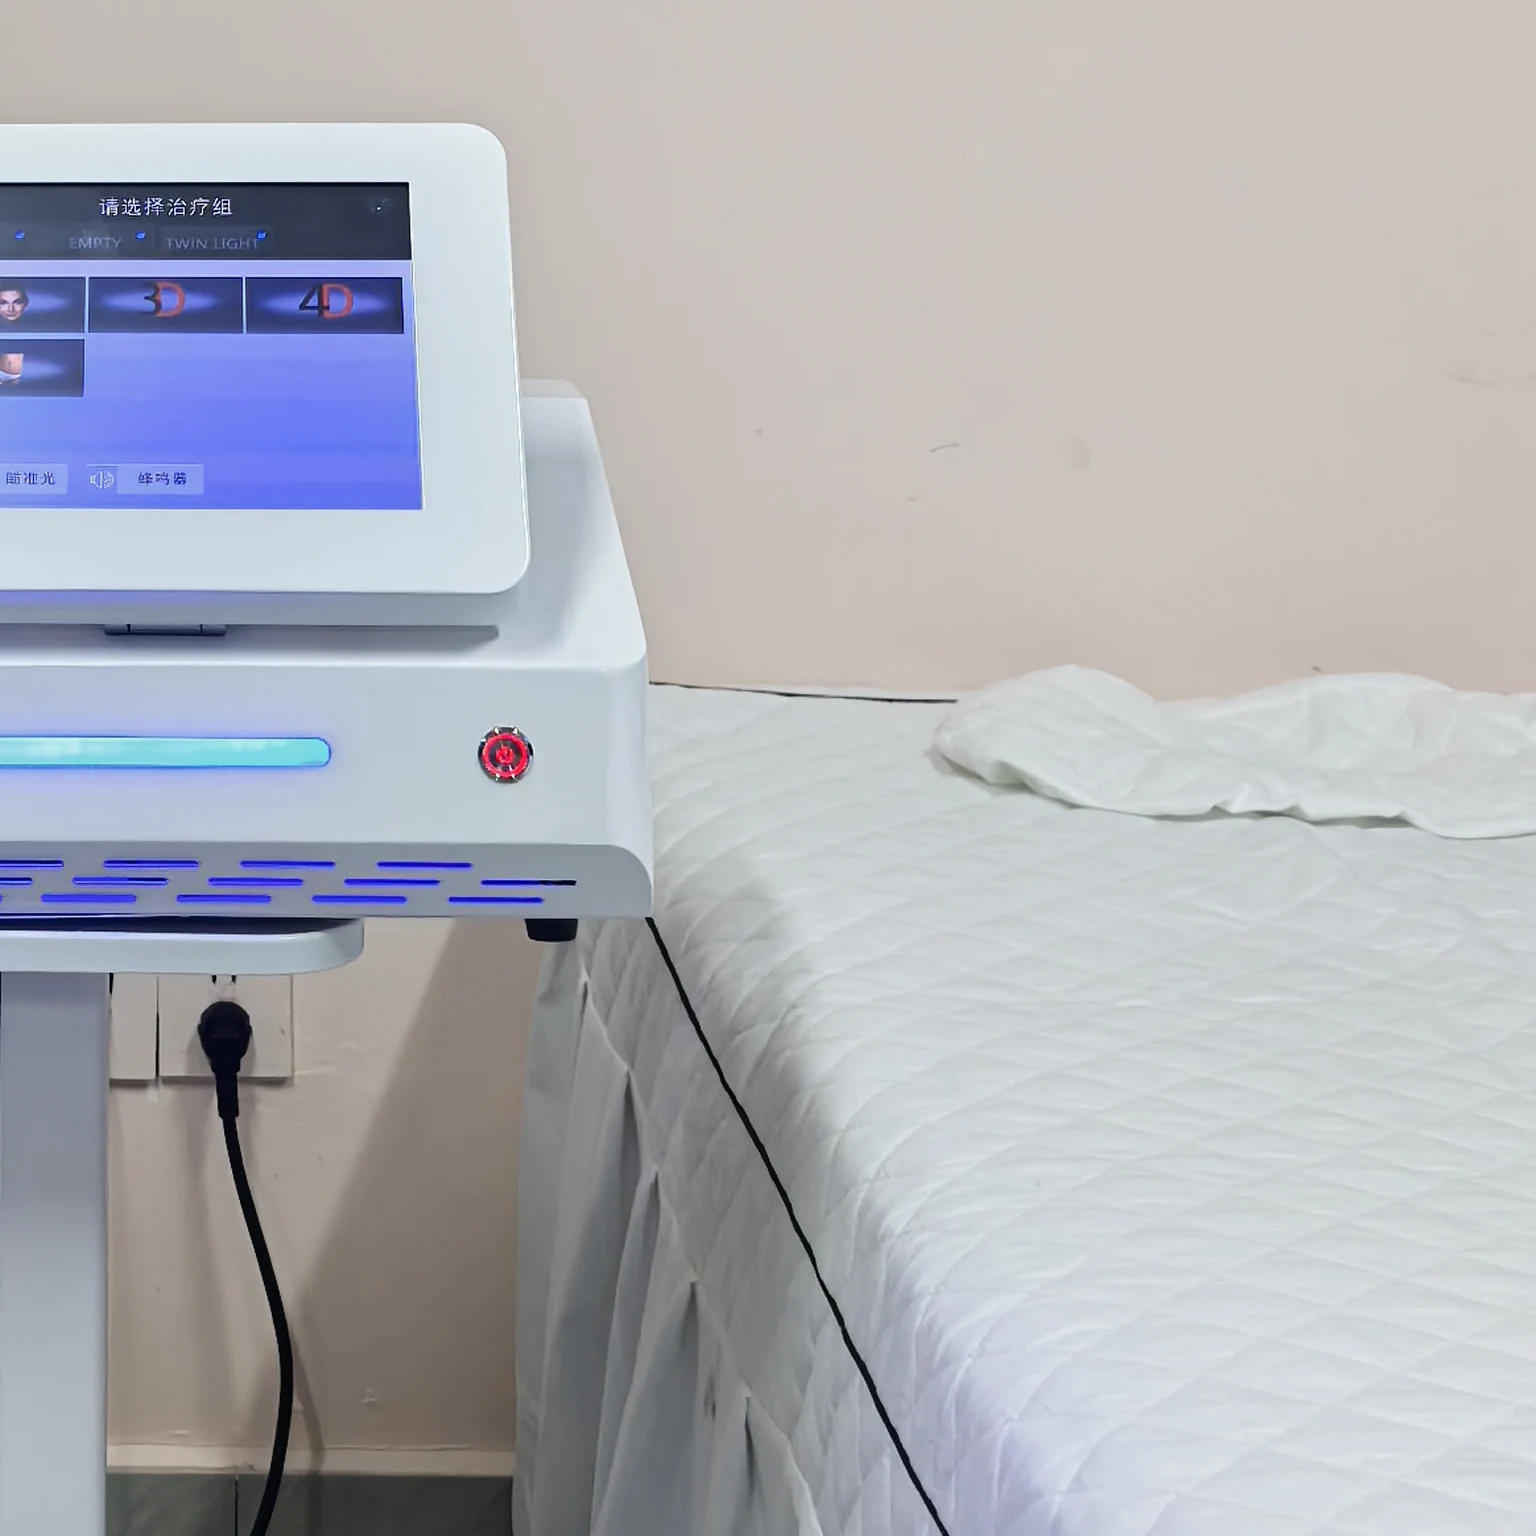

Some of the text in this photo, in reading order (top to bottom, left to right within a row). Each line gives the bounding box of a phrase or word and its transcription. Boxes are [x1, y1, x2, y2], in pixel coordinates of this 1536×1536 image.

[98, 196, 234, 217] 请选择治疗组
[69, 237, 123, 251] EMPTY
[165, 237, 260, 251] TWIN LIGHT
[137, 280, 185, 319] 3D
[298, 282, 354, 320] 4D
